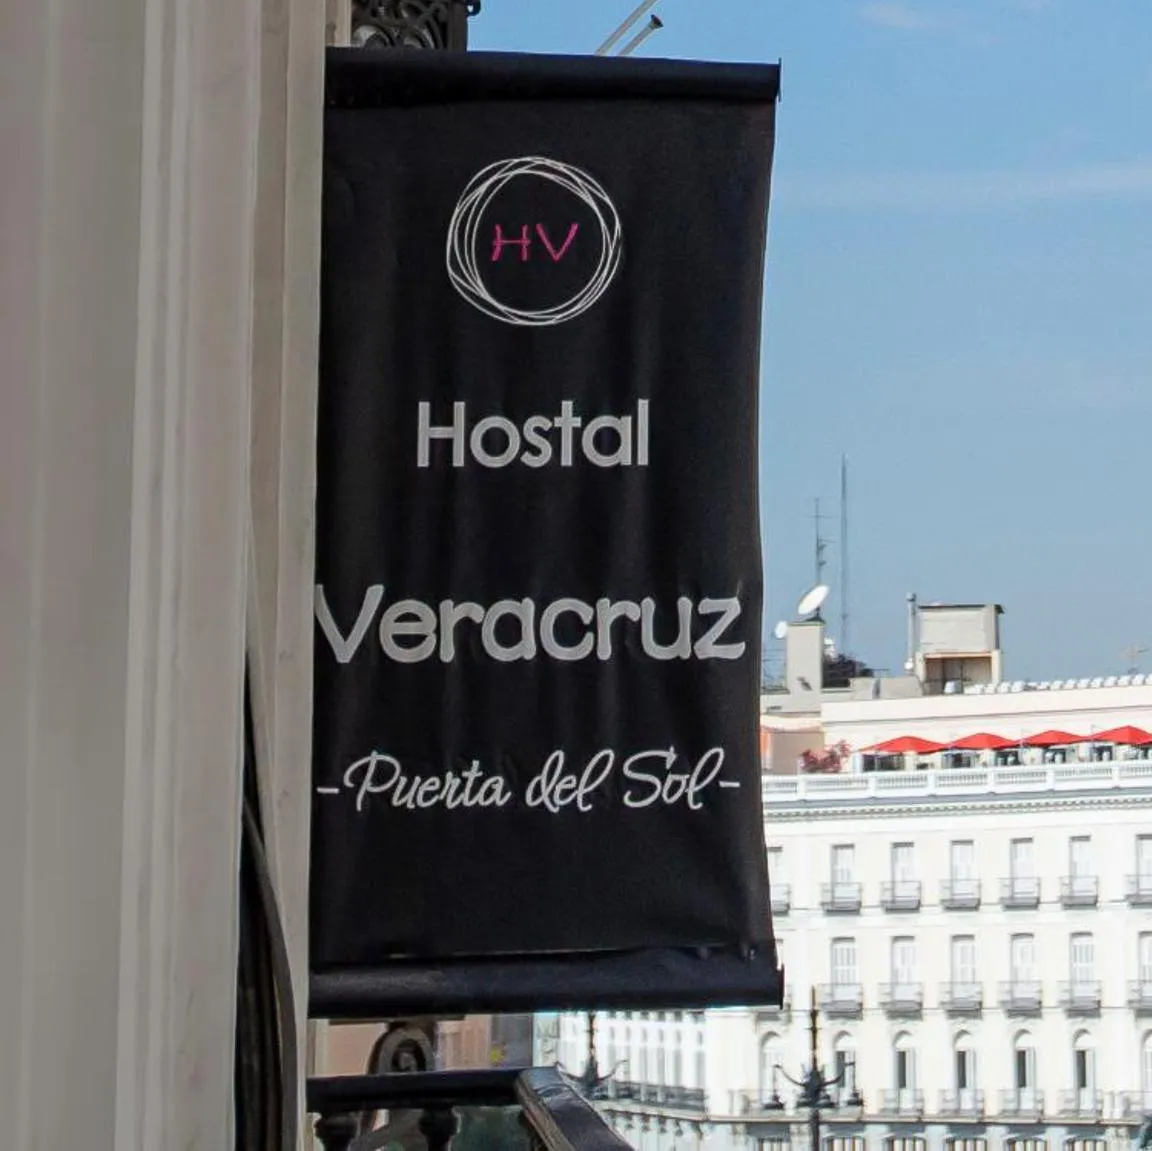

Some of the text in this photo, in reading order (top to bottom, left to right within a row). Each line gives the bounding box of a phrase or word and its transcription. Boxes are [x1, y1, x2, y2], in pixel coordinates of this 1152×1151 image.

[492, 222, 579, 262] HV
[416, 398, 650, 468] Hostal
[314, 583, 747, 663] Veracruz
[525, 748, 616, 813] del
